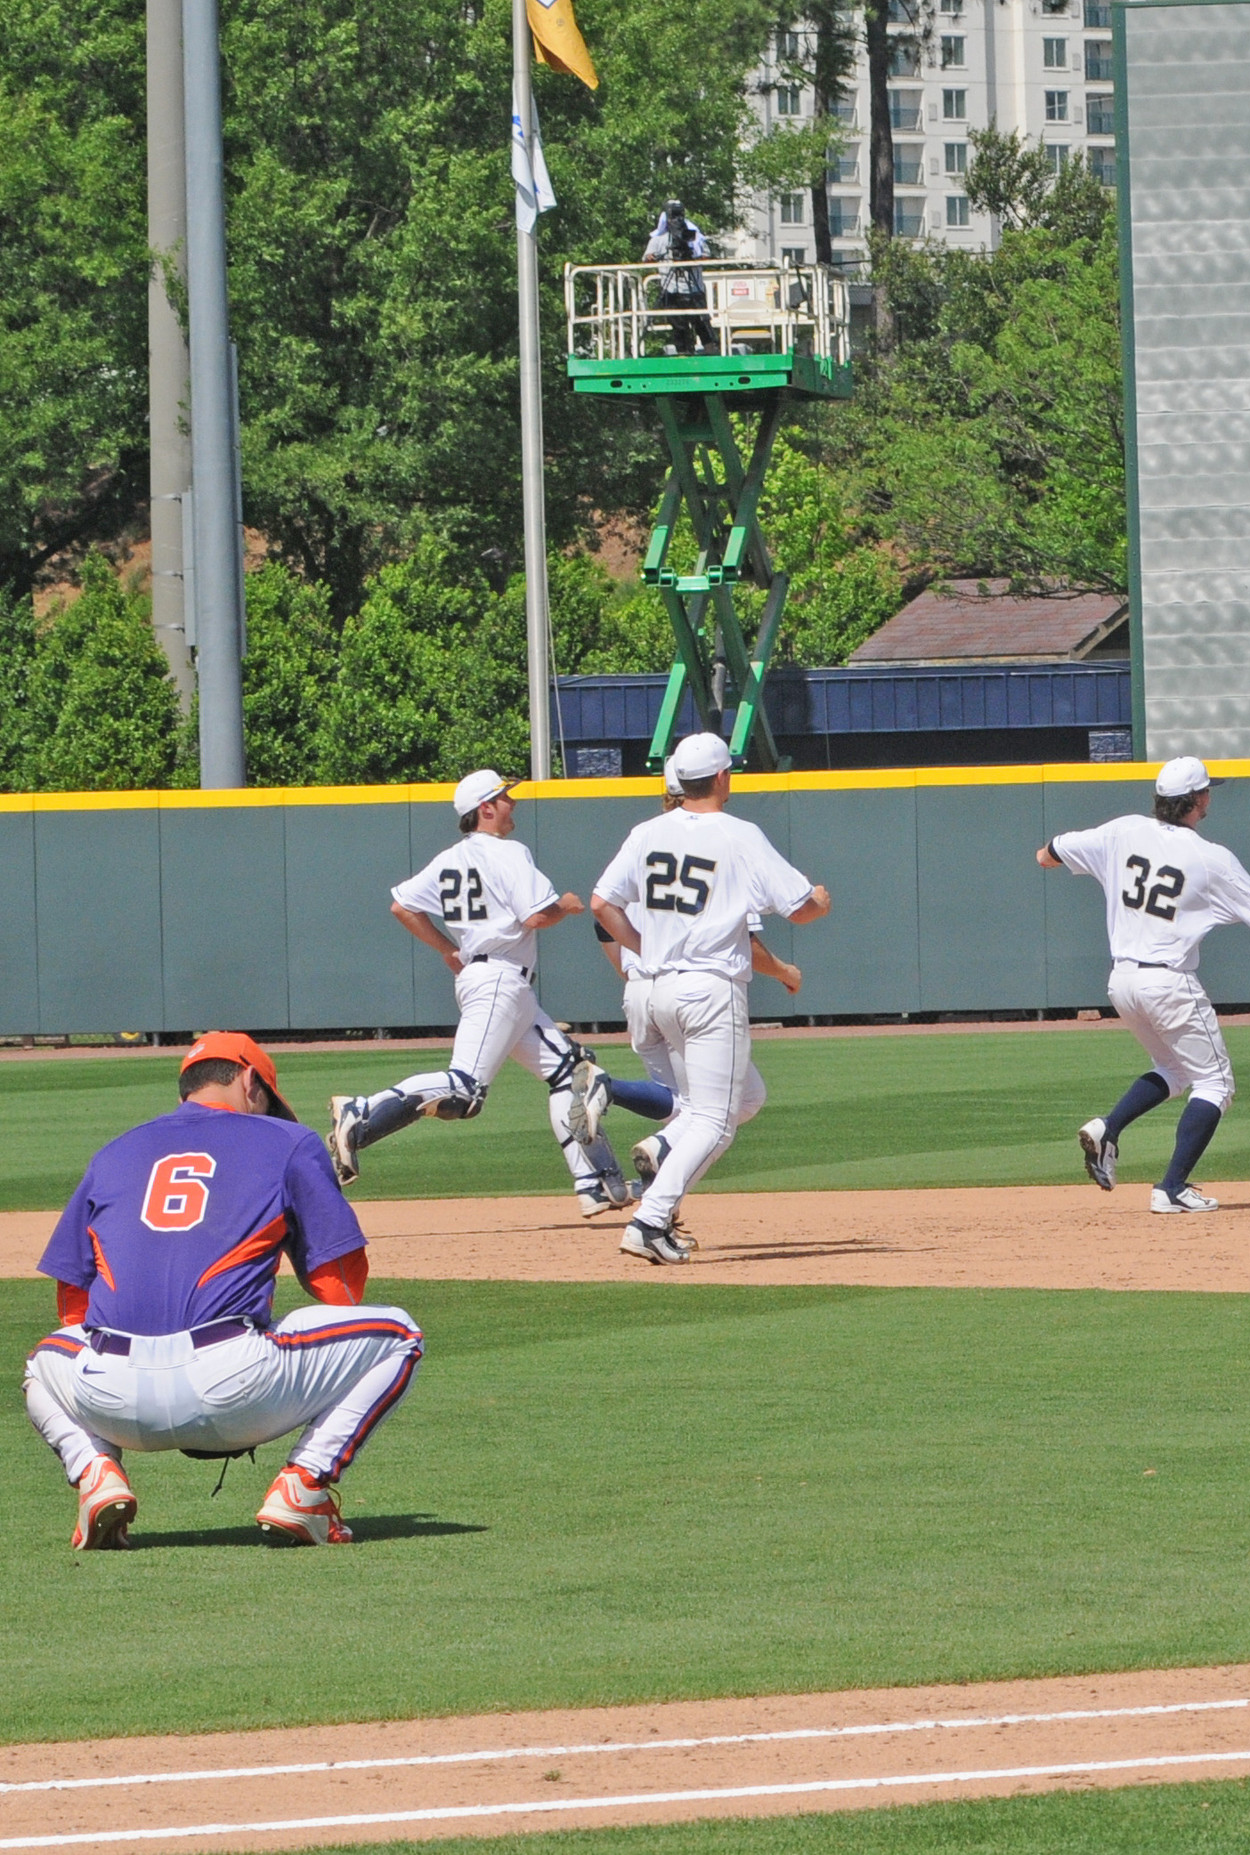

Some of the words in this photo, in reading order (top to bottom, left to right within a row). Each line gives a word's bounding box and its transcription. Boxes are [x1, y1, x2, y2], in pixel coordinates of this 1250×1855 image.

[439, 867, 489, 922] 22
[646, 851, 717, 917] 25
[1122, 854, 1185, 921] 32
[140, 1152, 217, 1231] 6
